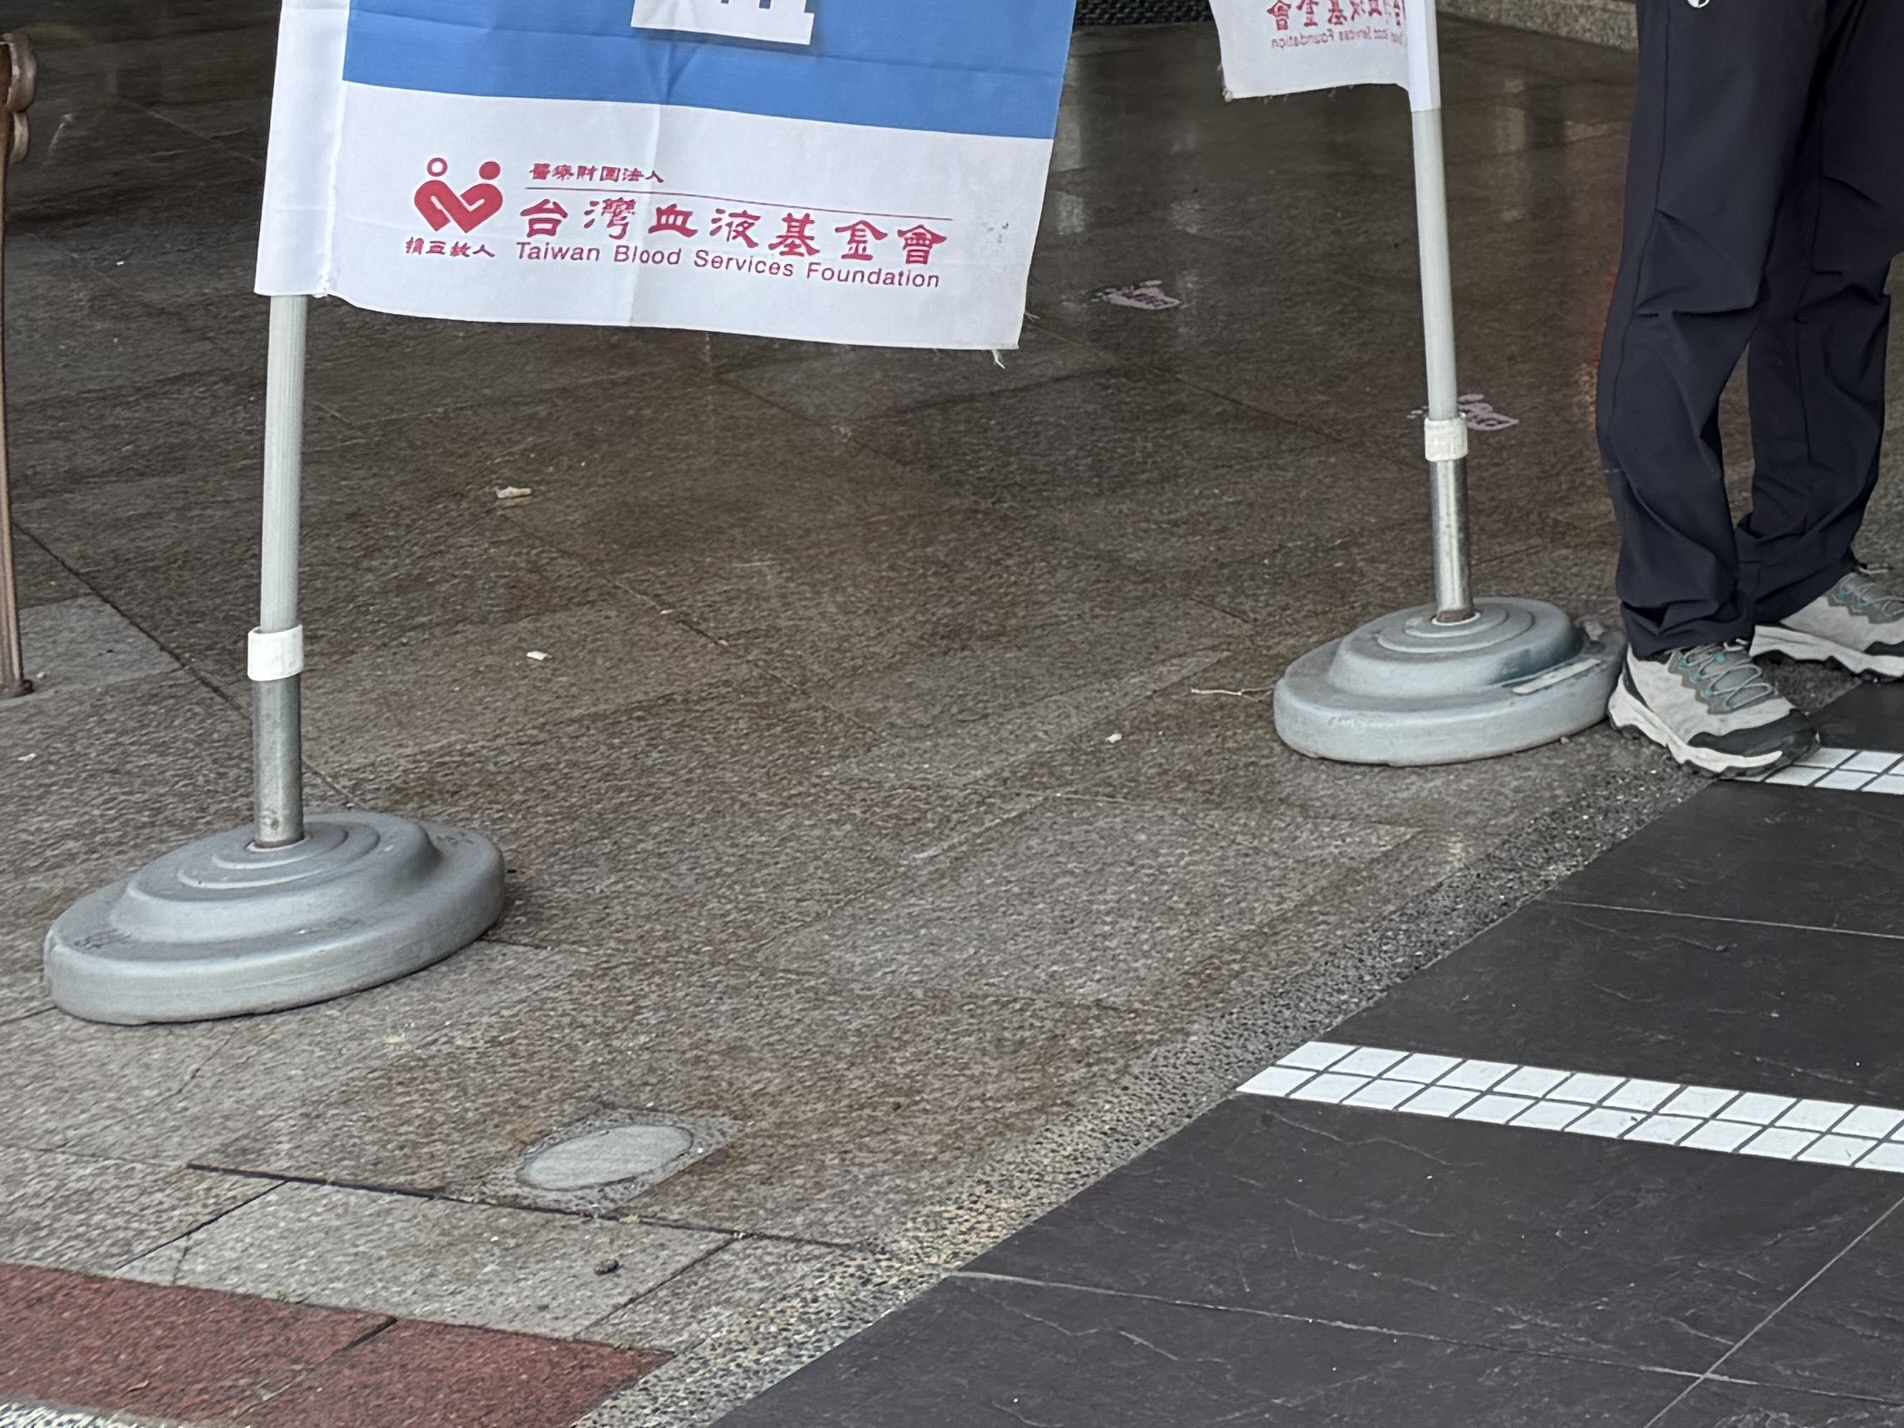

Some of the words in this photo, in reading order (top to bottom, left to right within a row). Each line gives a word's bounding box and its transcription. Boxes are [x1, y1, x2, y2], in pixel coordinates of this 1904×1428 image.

[519, 197, 948, 266] 台灣血液基金會
[516, 242, 600, 263] Taiwan
[613, 245, 681, 266] Blood
[694, 249, 795, 278] Services
[806, 262, 940, 289] Foundation
